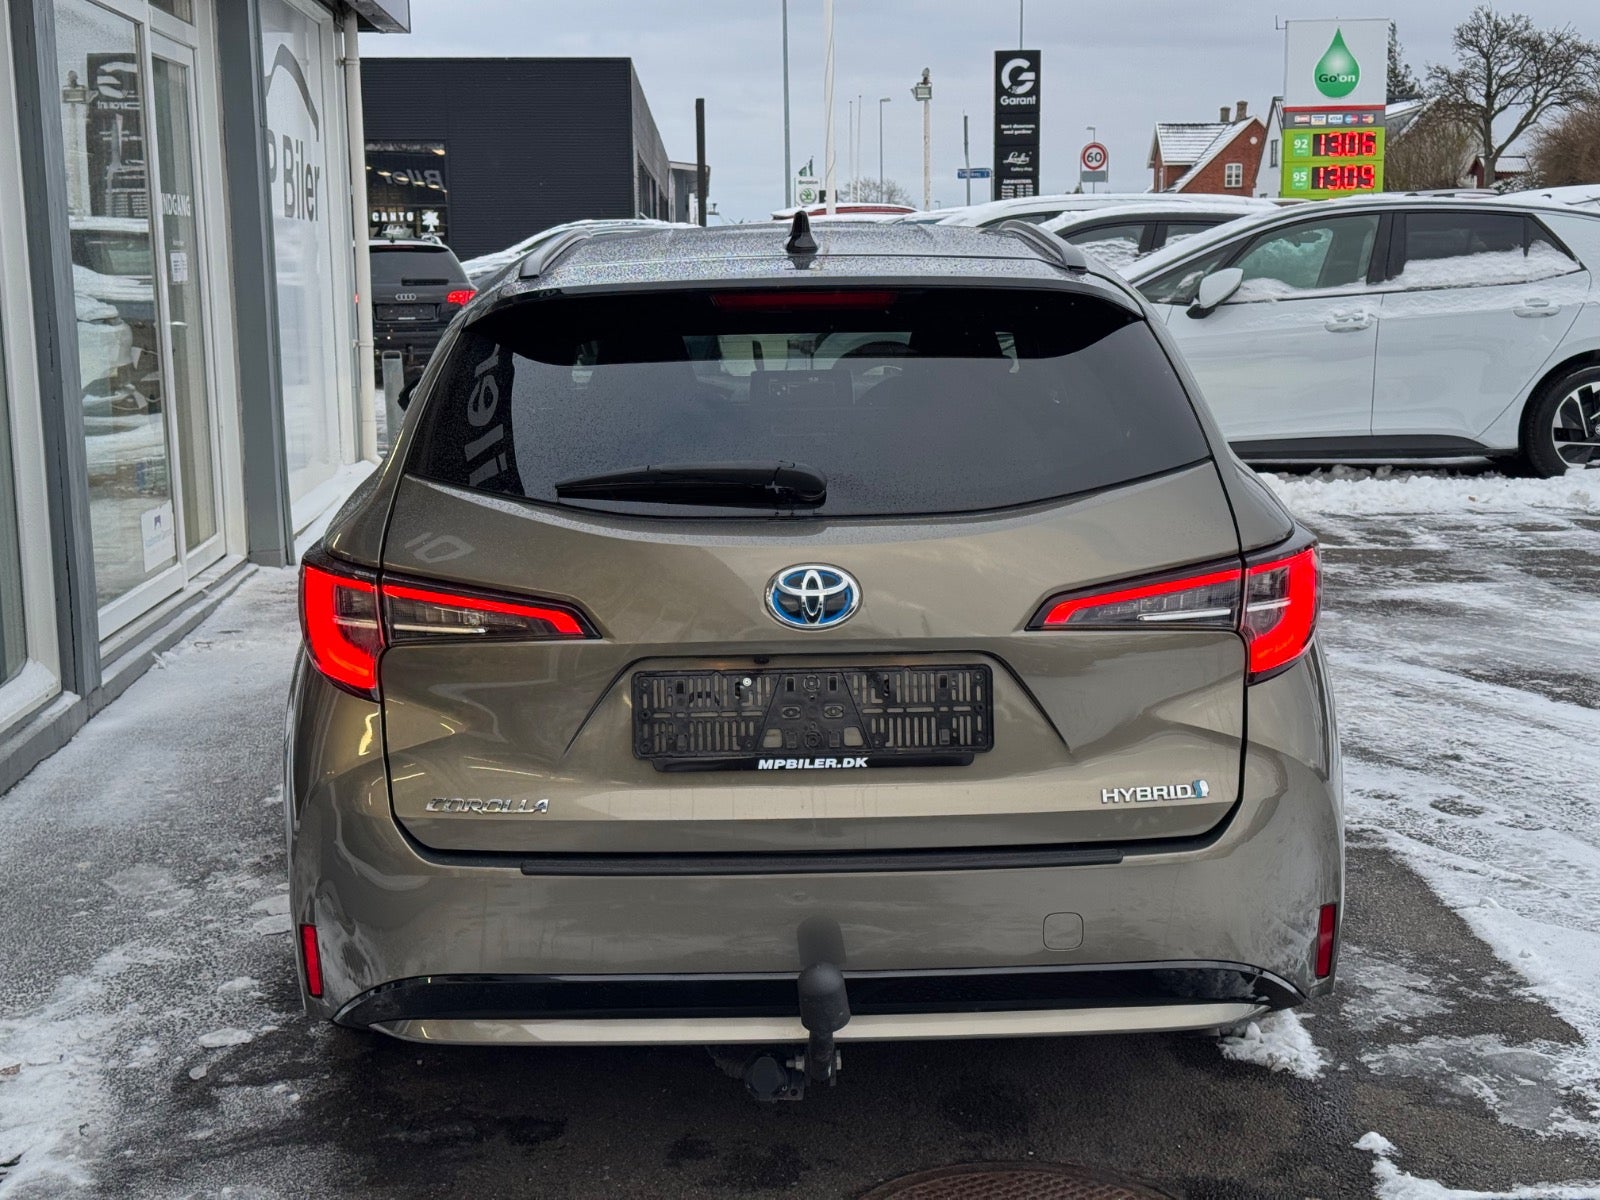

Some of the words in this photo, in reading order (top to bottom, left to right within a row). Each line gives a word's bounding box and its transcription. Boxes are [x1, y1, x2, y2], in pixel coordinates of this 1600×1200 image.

[1318, 72, 1356, 83] Go'on
[1000, 95, 1037, 106] Garant
[1294, 138, 1308, 149] 92
[1086, 152, 1102, 163] 60
[283, 134, 320, 222] Biler
[1292, 171, 1307, 182] 95
[757, 756, 869, 771] MPBILER.DK
[1101, 783, 1193, 804] HYBRID
[425, 797, 549, 815] COROLLA
